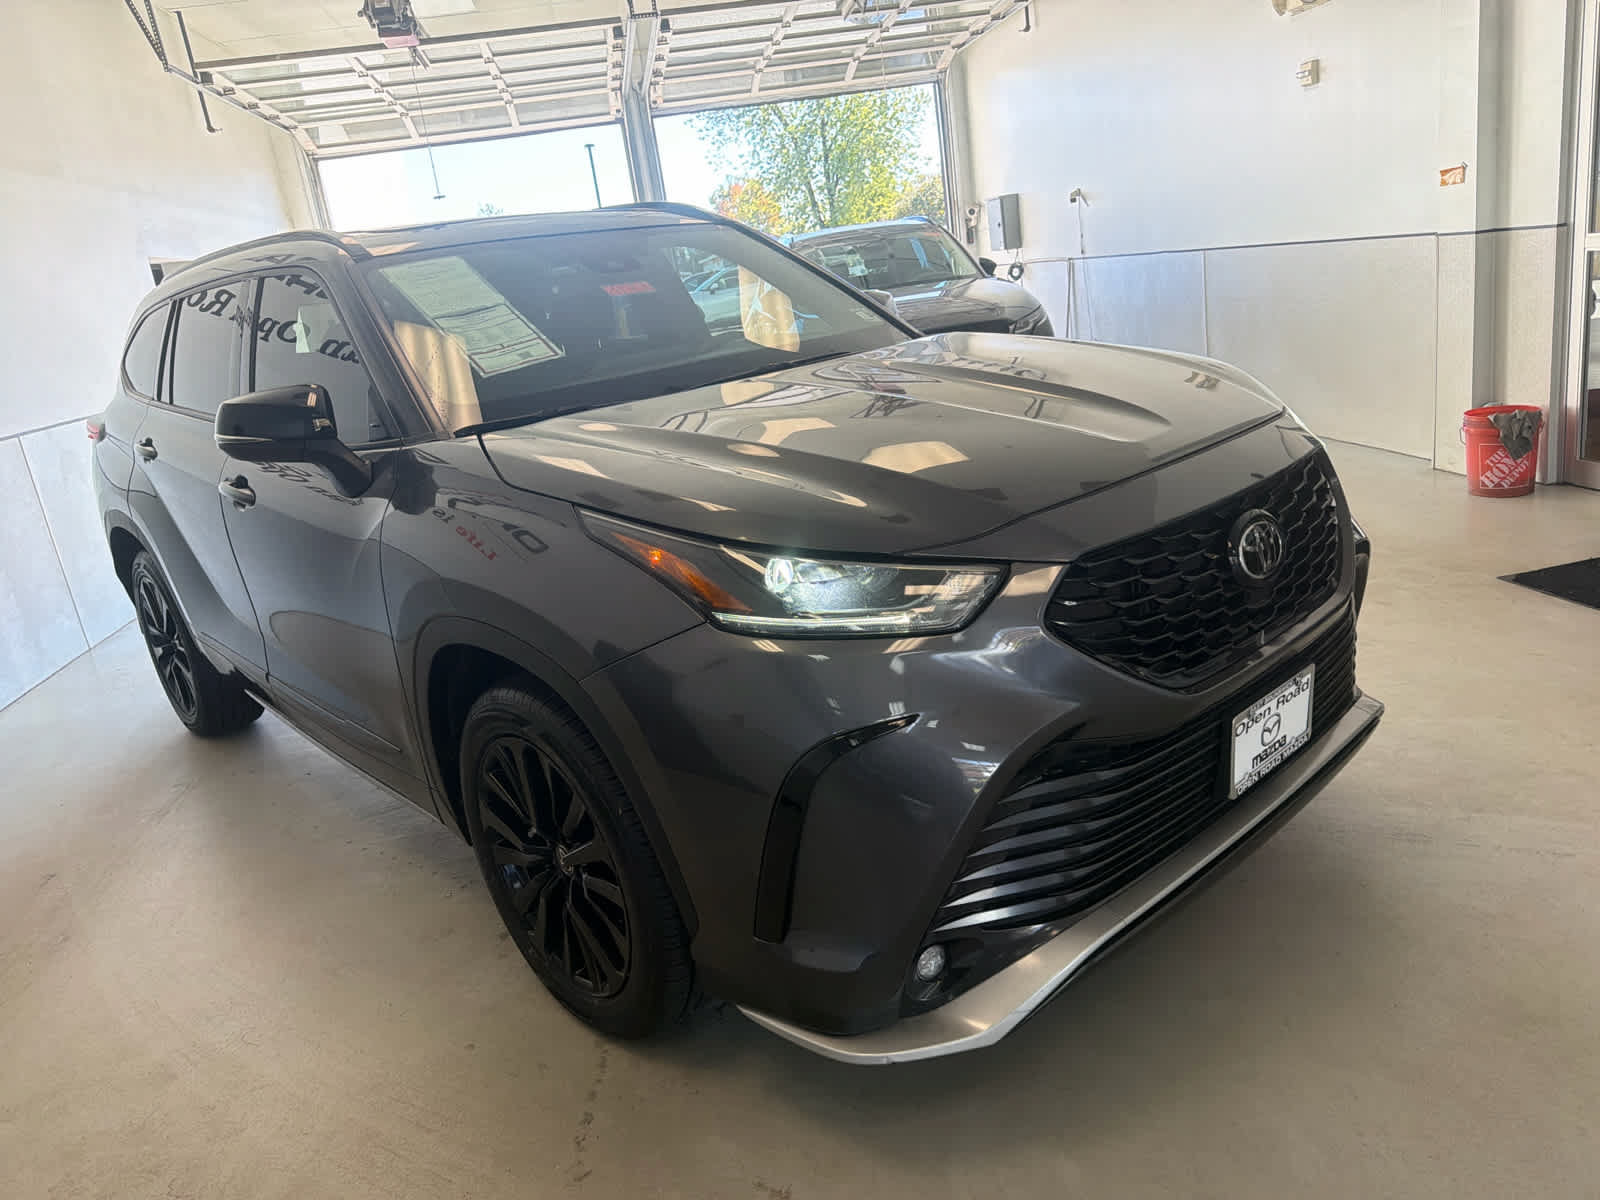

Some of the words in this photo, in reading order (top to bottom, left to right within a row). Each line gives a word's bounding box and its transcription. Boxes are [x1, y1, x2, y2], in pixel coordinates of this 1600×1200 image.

[1481, 456, 1522, 488] HOM
[1485, 448, 1506, 467] THE
[1500, 457, 1529, 488] DEPOT
[1234, 705, 1272, 738] Open
[1275, 677, 1311, 711] Road
[1251, 734, 1288, 769] mazda
